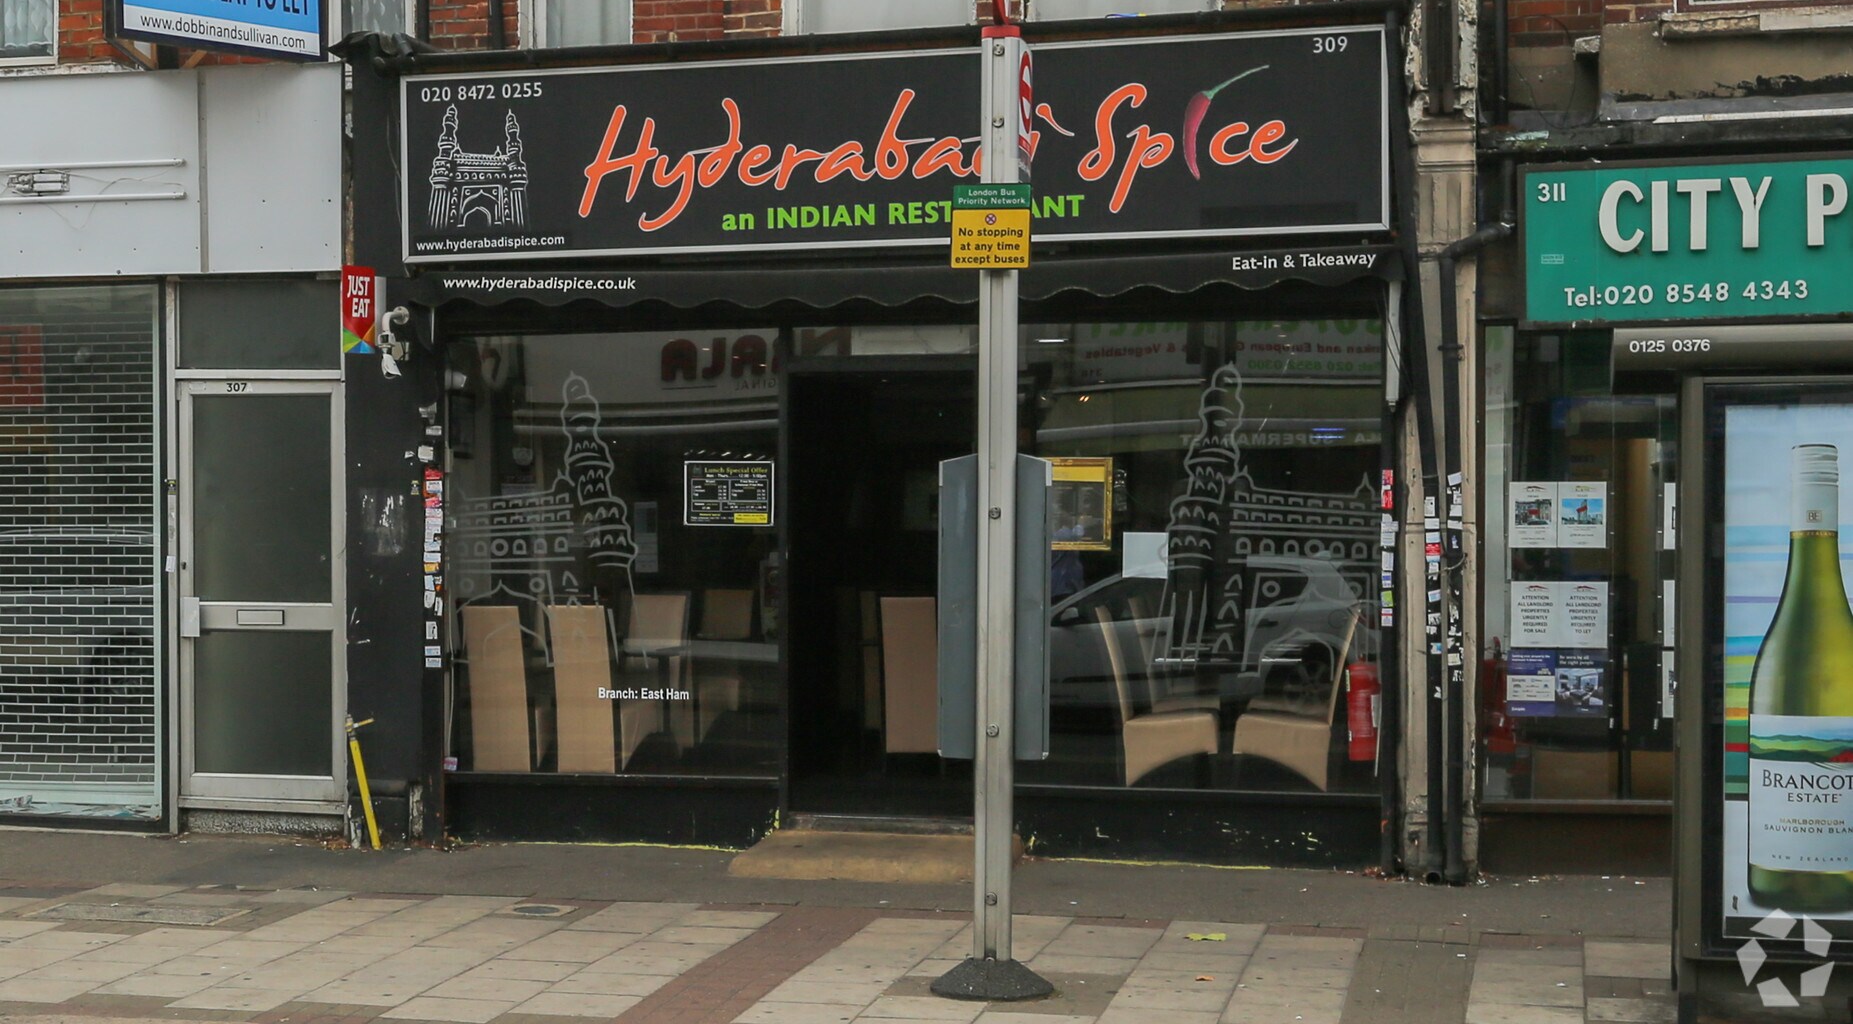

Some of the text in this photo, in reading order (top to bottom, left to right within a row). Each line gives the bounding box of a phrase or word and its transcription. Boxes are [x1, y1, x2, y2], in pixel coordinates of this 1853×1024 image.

[140, 12, 307, 50] www.dobbinandsullivan.com
[1313, 36, 1348, 54] 309
[421, 82, 543, 102] 020 8472 0255
[958, 197, 988, 205] Priority
[968, 188, 1016, 197] London Bus
[1537, 182, 1567, 202] 311
[721, 193, 1085, 232] an INDIAN RESTNT
[1598, 173, 1848, 254] CITY P
[958, 227, 1024, 238] No stopping
[416, 233, 565, 253] www.hyderabadispice.com
[960, 242, 1020, 253] at any time
[955, 254, 1025, 264] except buses
[1231, 251, 1377, 271] Eat-in & Takeaway
[347, 275, 371, 298] JUST
[442, 275, 636, 293] www.hyderabadispice.co.uk
[1666, 282, 1730, 304] 8548
[1742, 279, 1809, 300] 4343
[351, 298, 371, 318] EAT
[1629, 339, 1711, 353] 0125 0376
[226, 382, 248, 393] 307
[726, 467, 750, 475] Special
[598, 687, 690, 699] Branch: East Ham
[1764, 824, 1823, 833] SAUVIGNON
[1779, 818, 1845, 826] MARLBOROUGH
